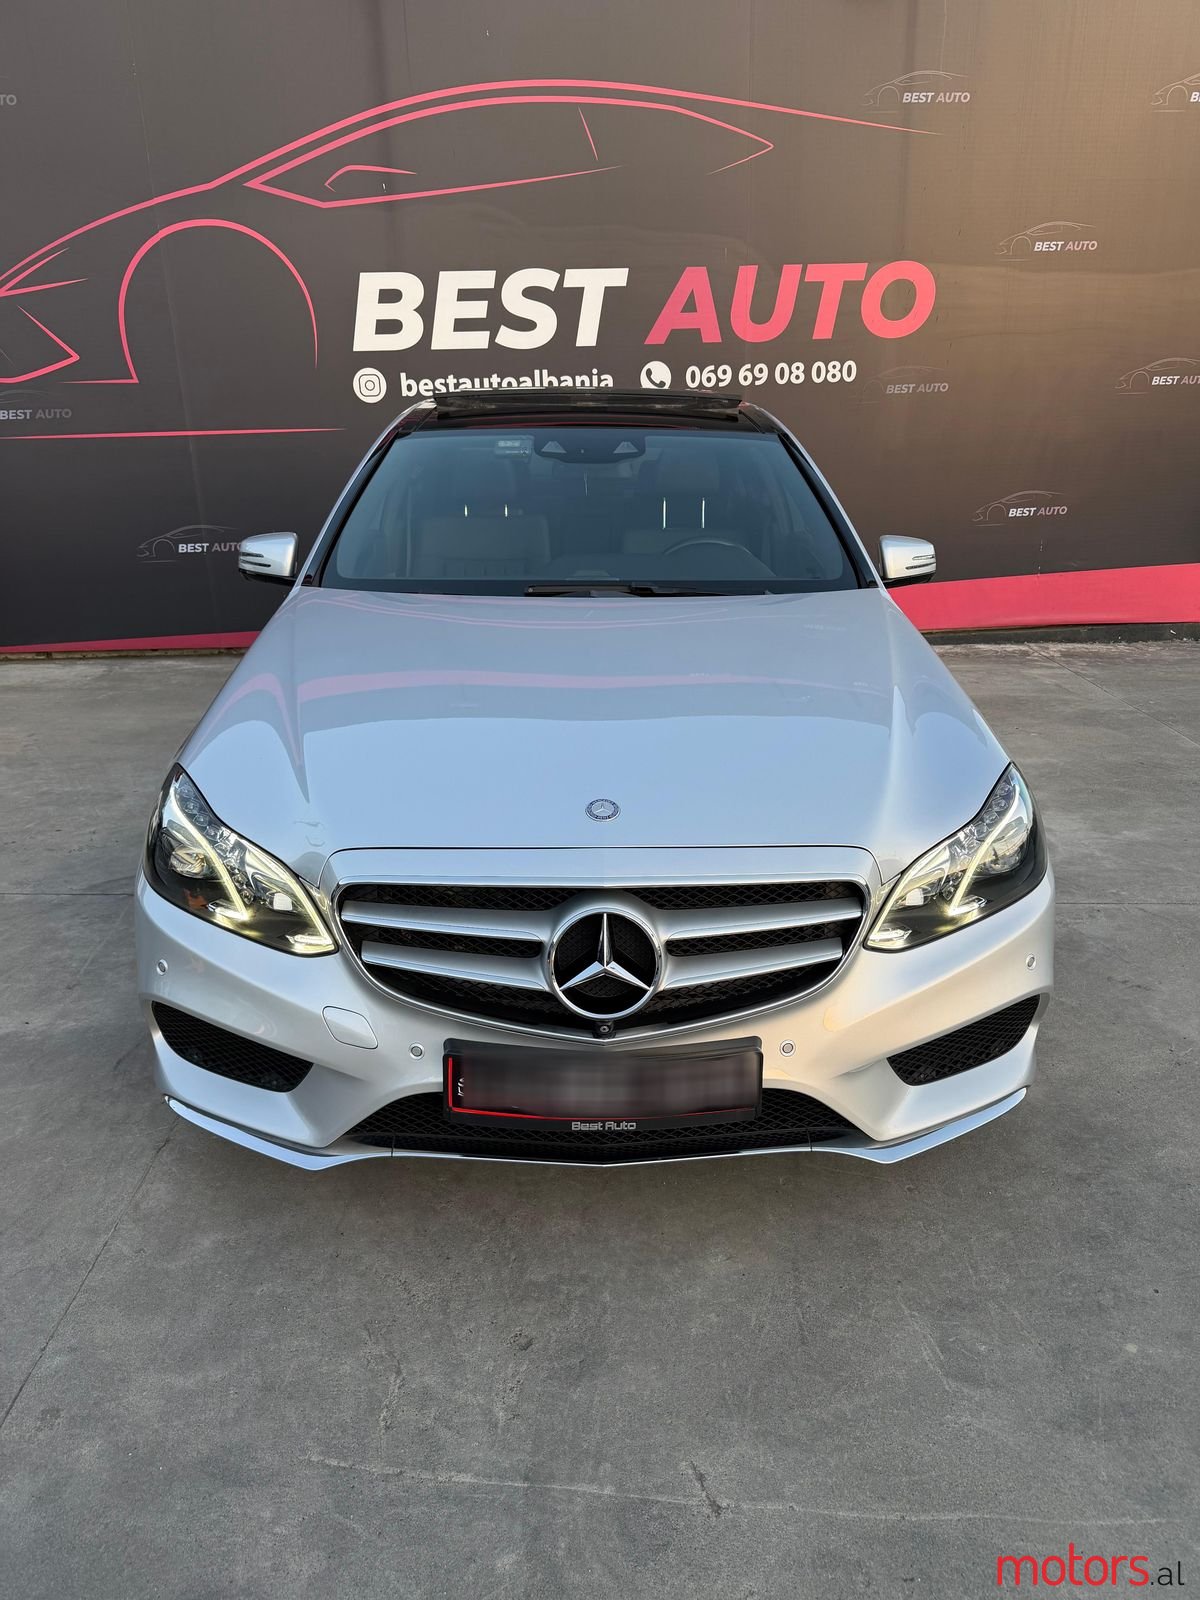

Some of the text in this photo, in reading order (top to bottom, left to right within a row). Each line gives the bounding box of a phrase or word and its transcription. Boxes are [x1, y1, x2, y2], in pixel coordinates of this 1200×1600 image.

[902, 92, 971, 103] BEST AUTO
[1190, 91, 1200, 102] B
[1034, 240, 1098, 252] BEST AUTO
[353, 260, 937, 352] BEST AUTO
[686, 360, 857, 389] 069 69 08 080
[1151, 375, 1181, 385] BEST
[886, 383, 949, 394] BEST AUTO
[0, 408, 72, 420] BEST AUTO
[1008, 506, 1068, 517] BEST AUTO
[178, 543, 209, 553] BEST
[571, 1121, 637, 1131] Best Auto
